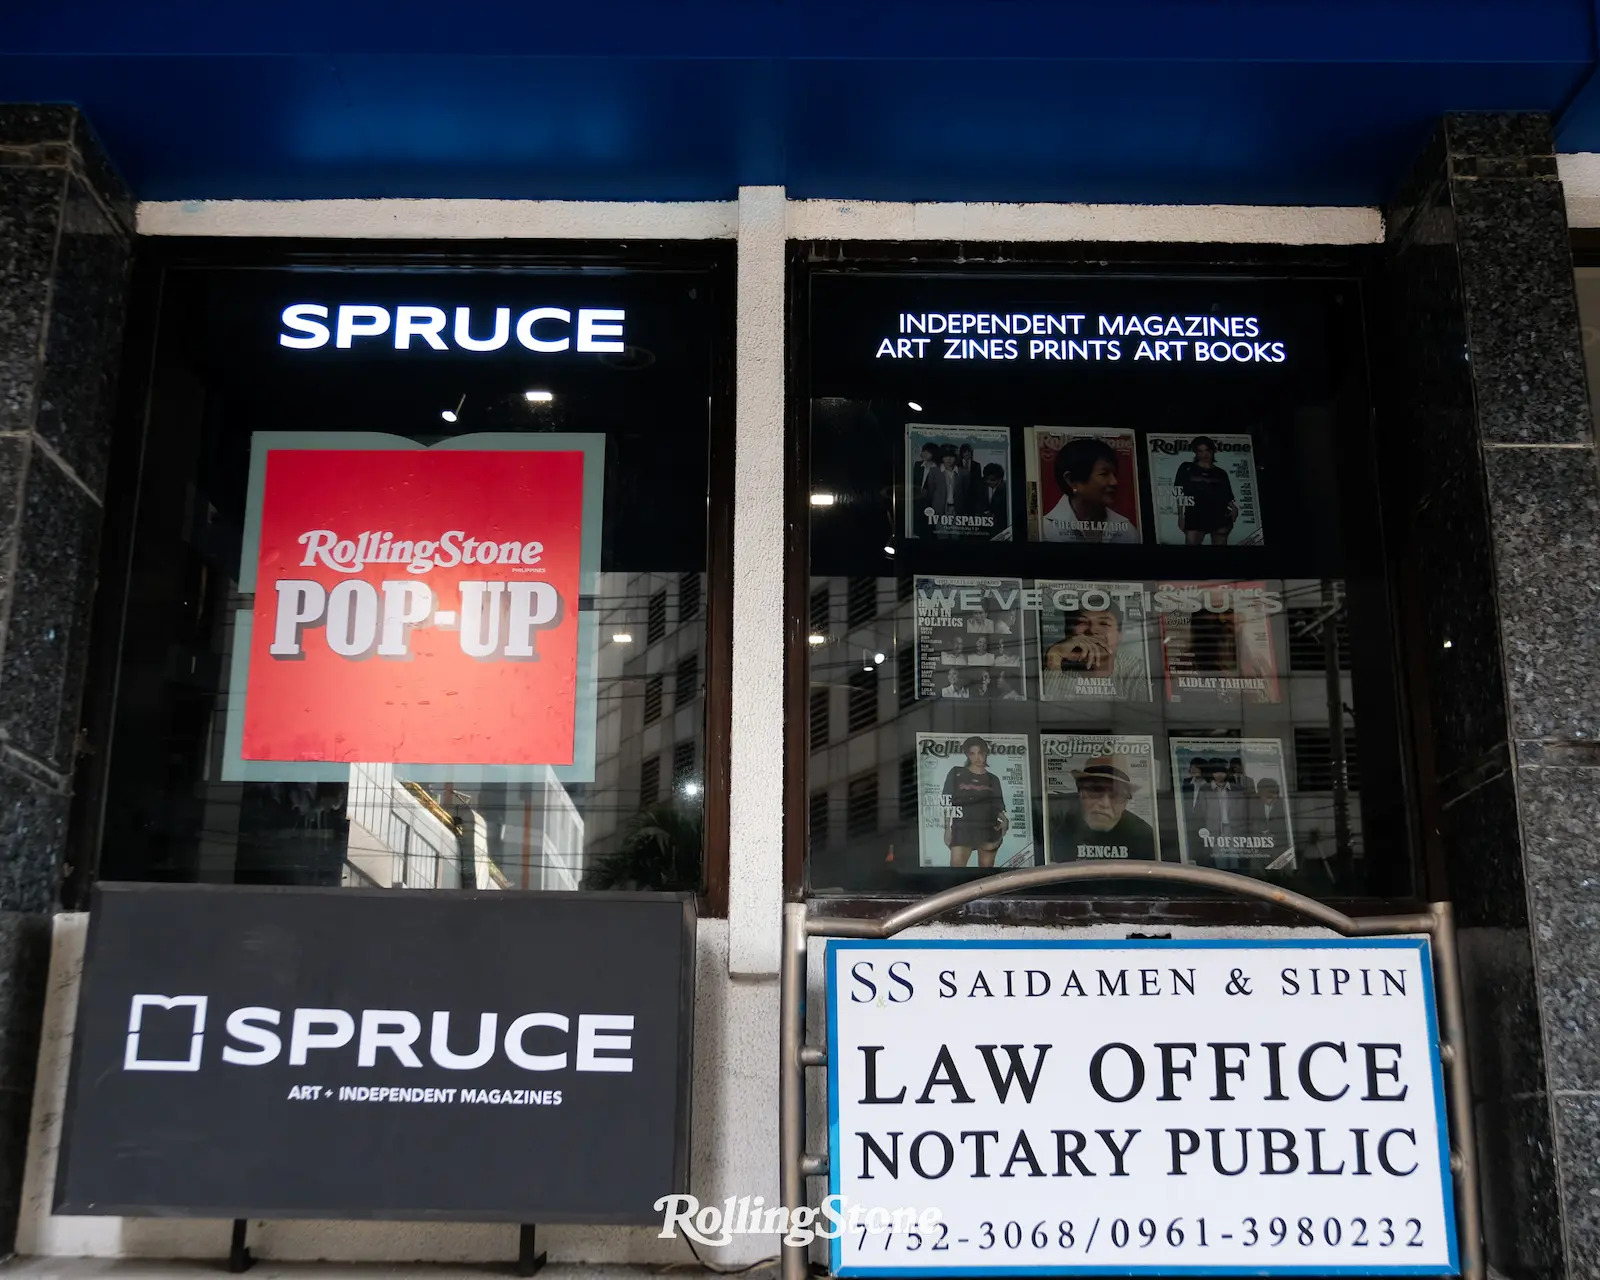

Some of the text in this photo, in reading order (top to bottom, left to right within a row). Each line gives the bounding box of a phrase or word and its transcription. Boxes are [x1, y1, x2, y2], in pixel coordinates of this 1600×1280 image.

[279, 303, 625, 353] SPRUCE
[898, 313, 1259, 338] INDEPENDENT MAGAZINES
[875, 338, 1286, 363] ART ZINES PRINTS ART BOOKS
[927, 514, 995, 527] IV OF SPADES
[917, 588, 1043, 612] WE'VE
[1052, 589, 1135, 613] GOT
[1144, 591, 1284, 614] ISSUES
[917, 607, 952, 618] WIN IN
[269, 579, 562, 660] POP-UP
[917, 616, 964, 628] POLITICS
[1075, 686, 1117, 696] PADILLA
[1077, 677, 1114, 687] DANIEL
[1178, 677, 1265, 690] KIDLAT TAHIMIK
[1076, 845, 1130, 859] BENCAB
[1203, 836, 1276, 849] IV OF SPADES
[938, 967, 1409, 999] SAIDAMEN & SIPIN
[221, 1005, 635, 1074] SPRUCE
[857, 1041, 1410, 1105] LAW OFFICE
[287, 1085, 323, 1101] ART
[338, 1086, 457, 1104] INDEPENDENT
[461, 1088, 563, 1106] MAGAZINES
[854, 1126, 1420, 1181] NOTARY PUBLIC
